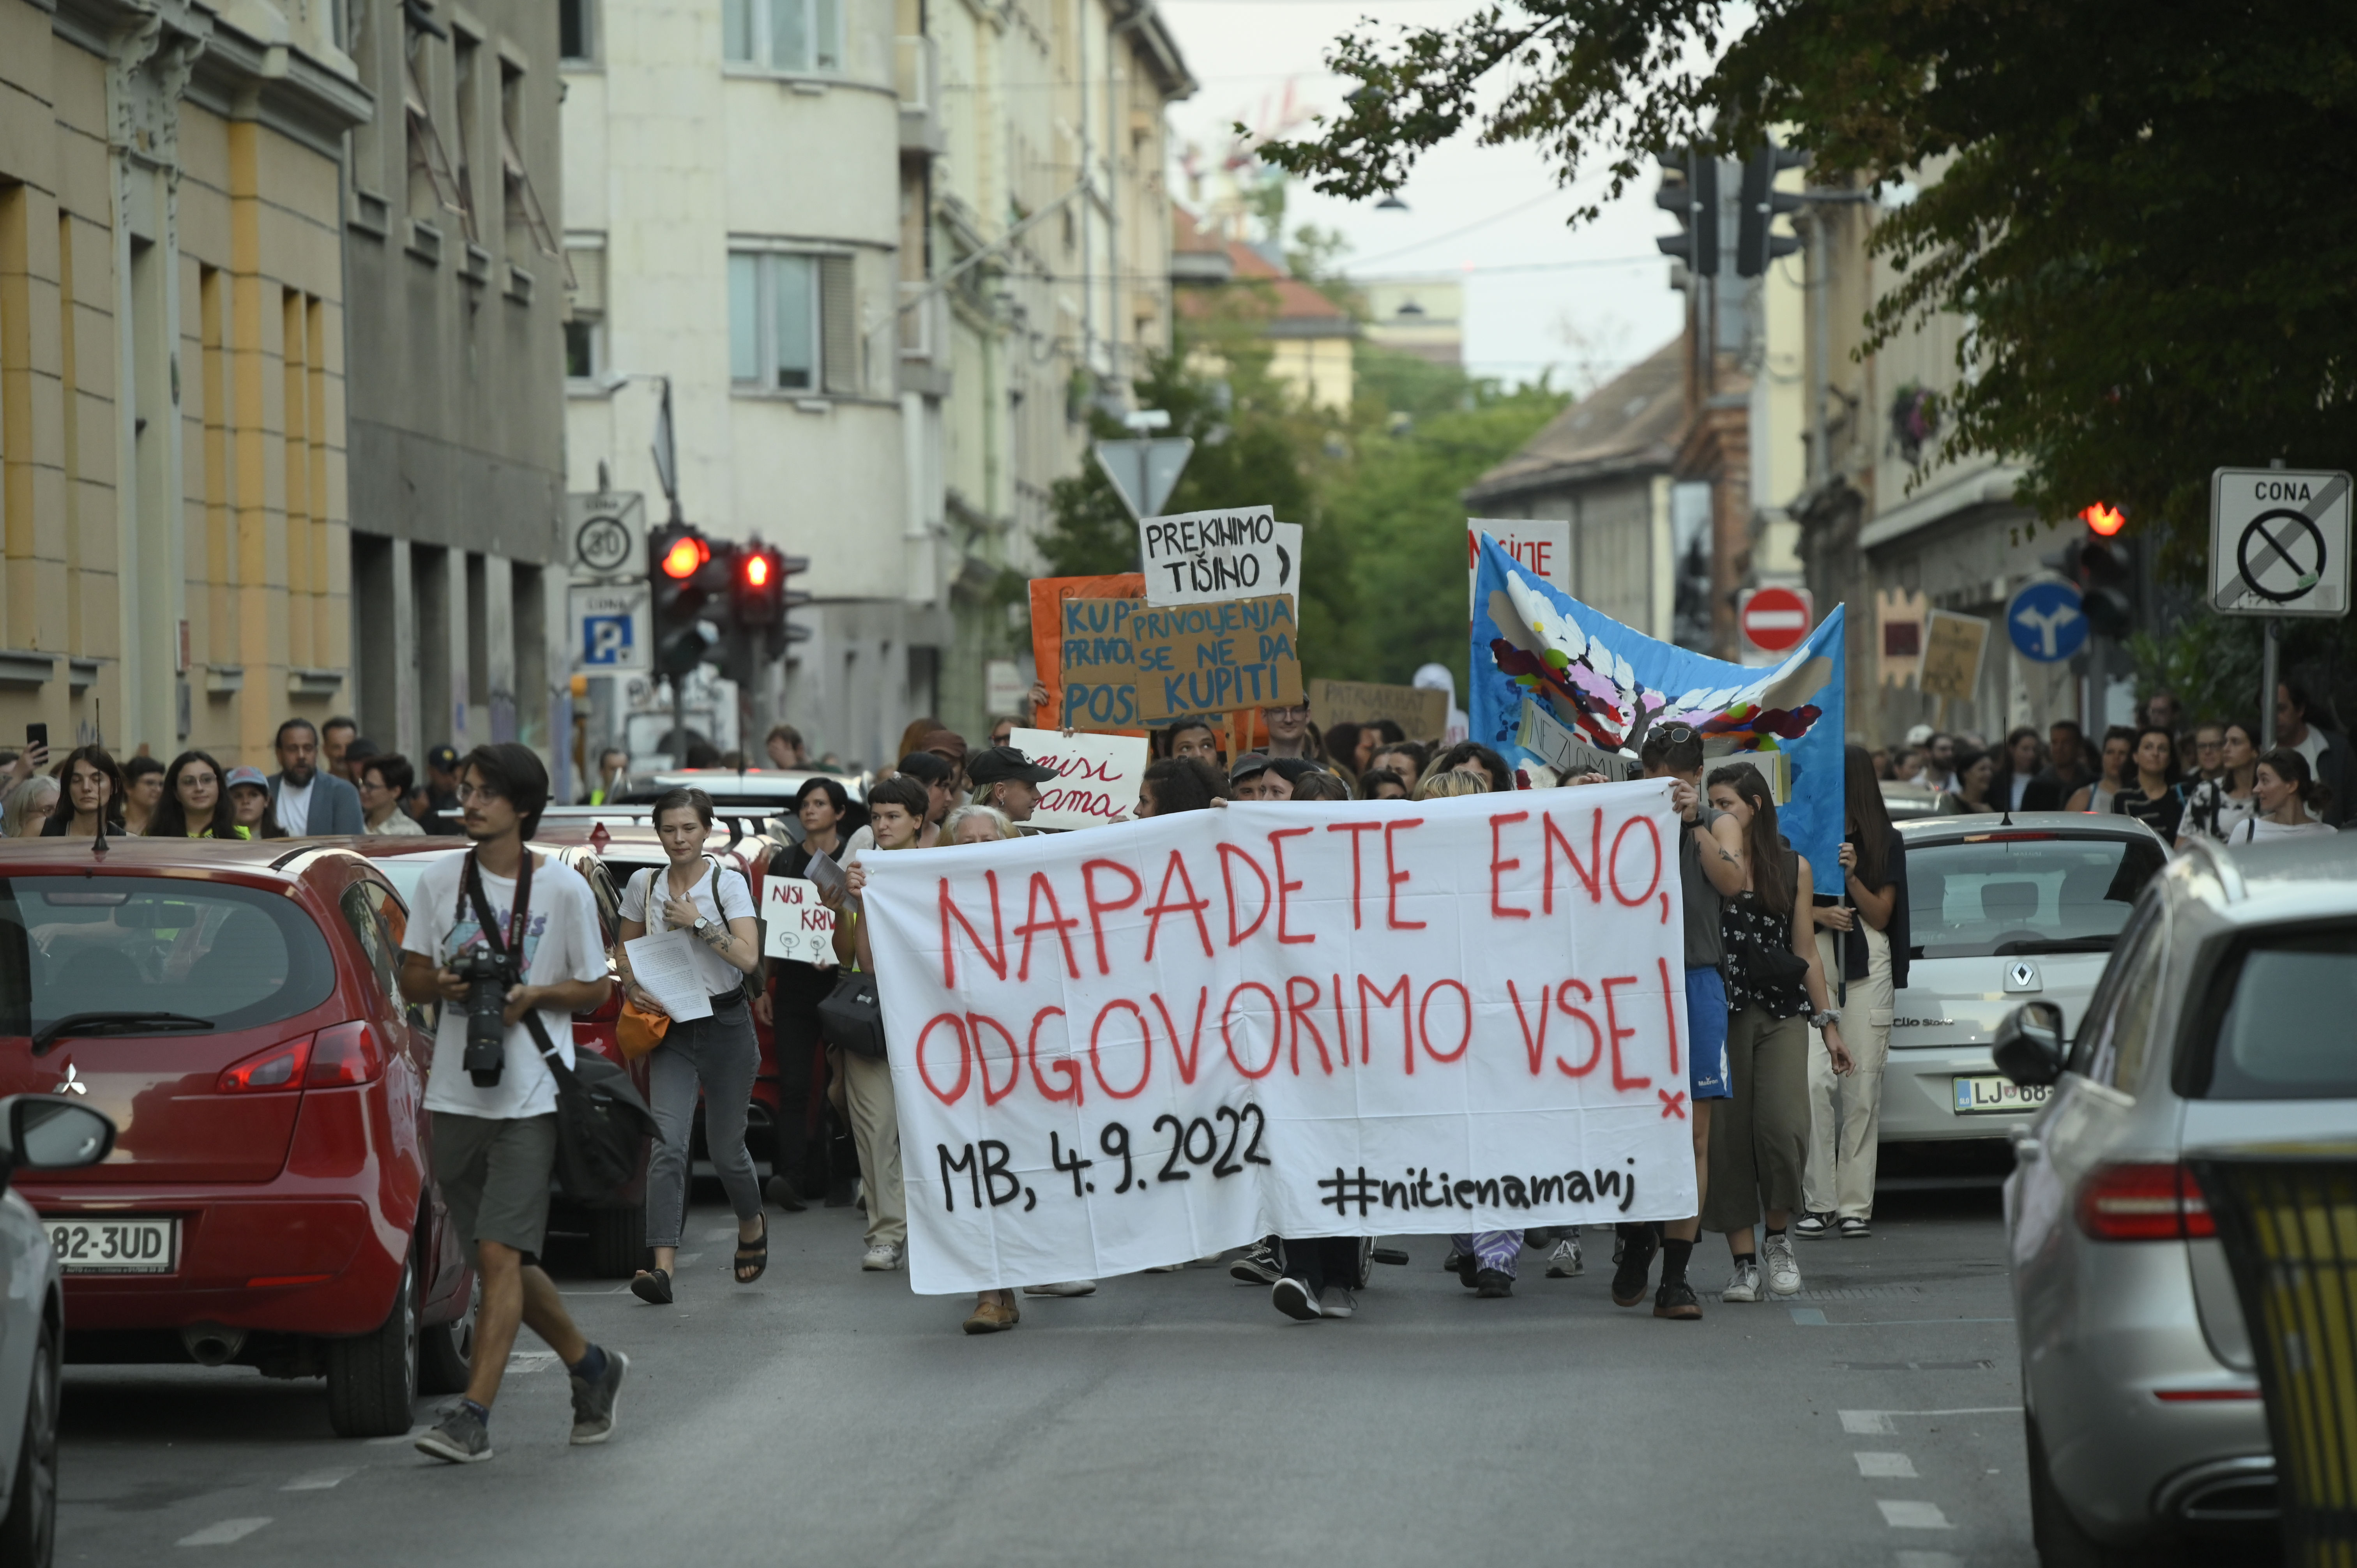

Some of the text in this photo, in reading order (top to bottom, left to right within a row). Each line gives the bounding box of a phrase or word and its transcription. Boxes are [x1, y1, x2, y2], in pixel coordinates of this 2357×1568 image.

[2254, 482, 2312, 501] CONA
[1066, 600, 1139, 635] KUP
[1133, 599, 1293, 641] PRIVOLJENJA
[1064, 637, 1135, 670] PRIVO
[1139, 632, 1295, 672] SE NE DA
[1164, 663, 1279, 714] KUPITI
[1529, 710, 1552, 759] NE
[1034, 788, 1127, 817] ama
[772, 884, 803, 904] NISI
[938, 807, 1670, 989] NAPADETE ENO,
[916, 957, 1686, 1119] ODGOVORIMO VSE!
[1975, 1081, 2002, 1104] LJ
[936, 1102, 1272, 1212] MB, 4.9.2022
[1317, 1157, 1635, 1217] #nitienamanj
